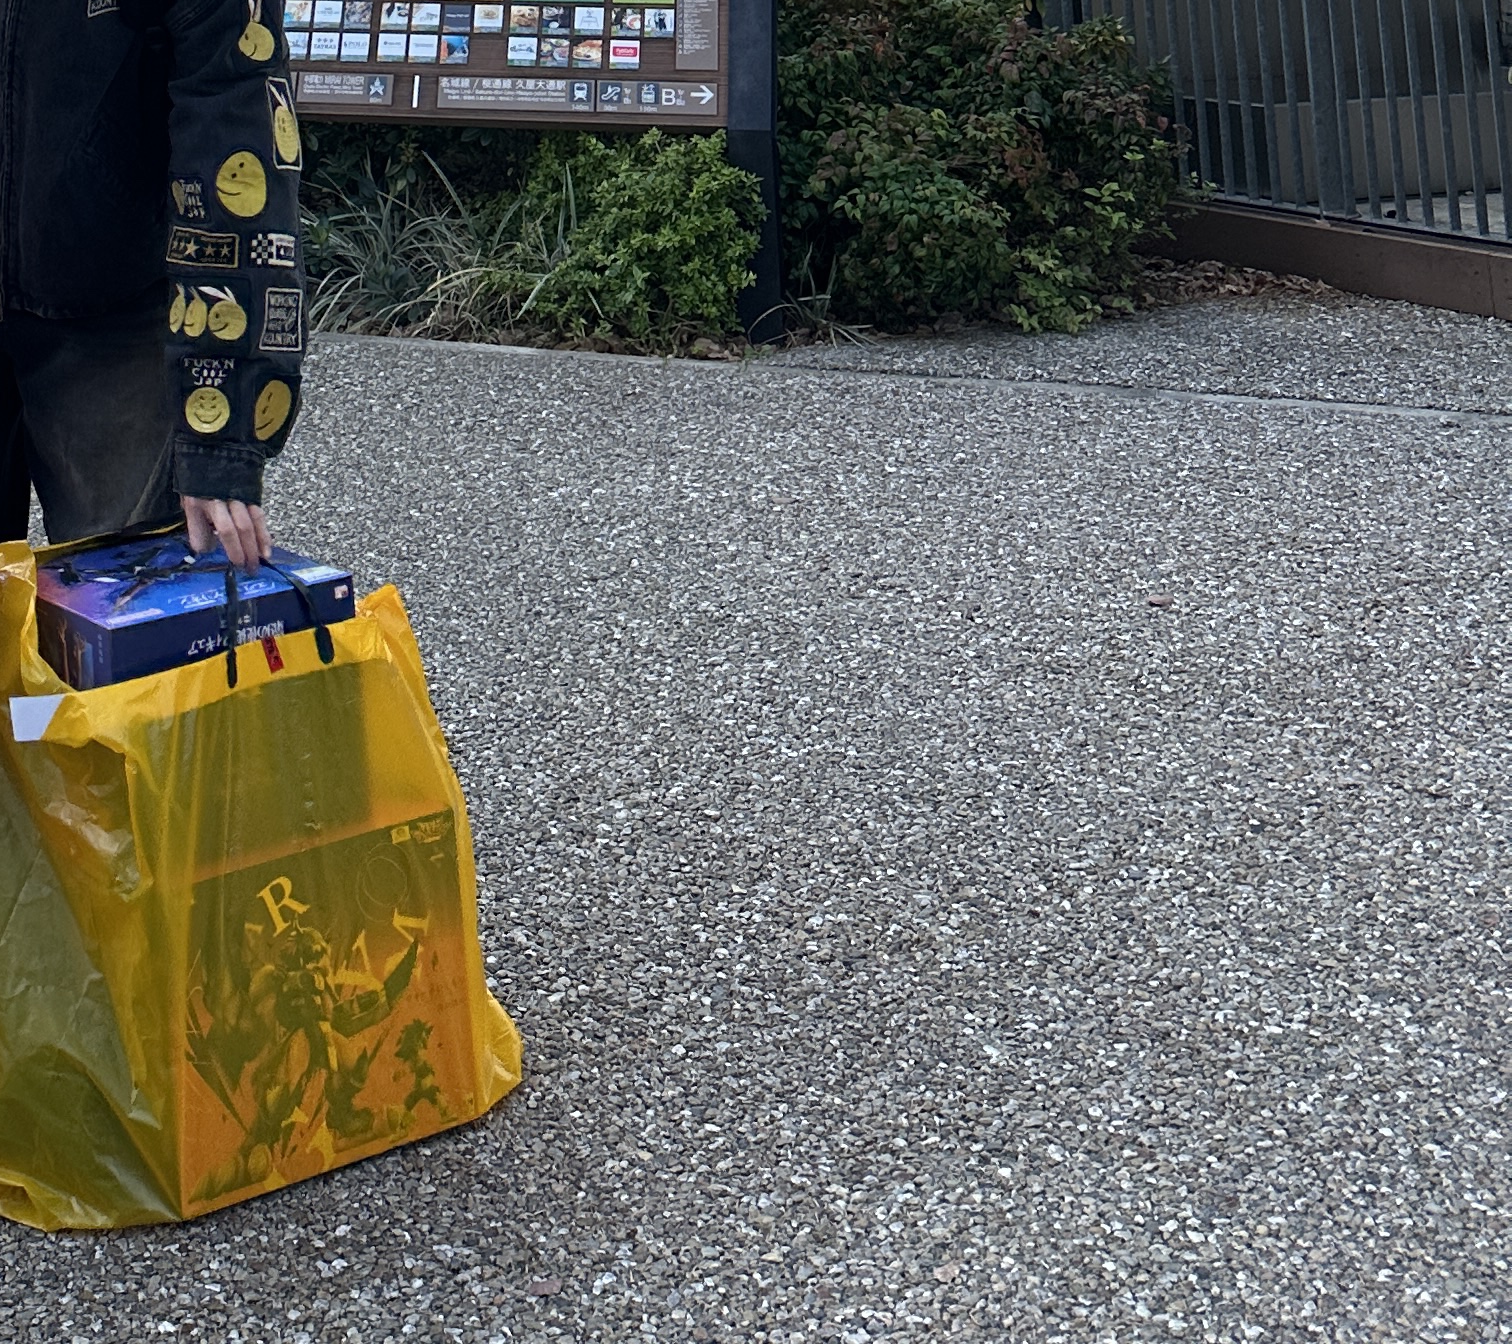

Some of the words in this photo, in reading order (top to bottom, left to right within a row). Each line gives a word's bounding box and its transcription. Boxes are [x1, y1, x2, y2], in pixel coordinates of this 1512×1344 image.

[515, 79, 567, 90] 久屋大通駅
[256, 876, 310, 938] R
